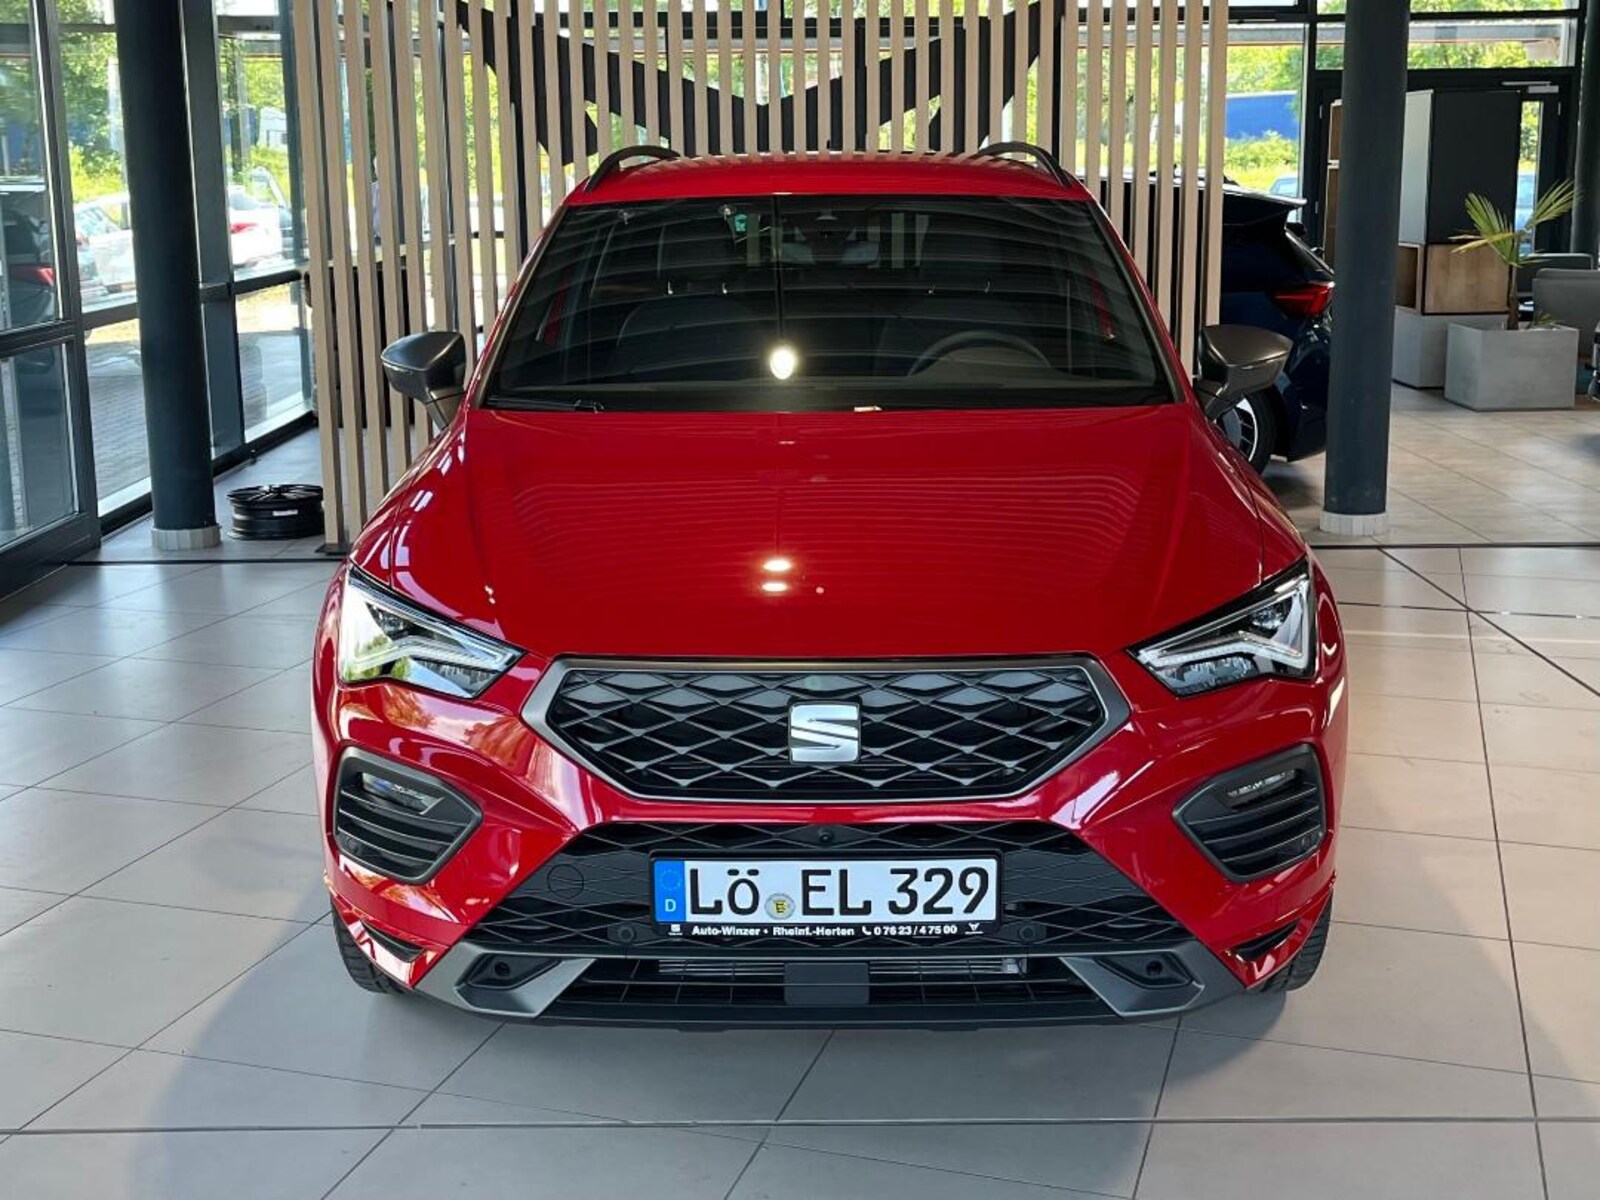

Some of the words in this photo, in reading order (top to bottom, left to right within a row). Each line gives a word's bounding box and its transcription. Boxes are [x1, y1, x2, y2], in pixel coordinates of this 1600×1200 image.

[690, 868, 760, 915] LÖ
[801, 869, 872, 916] EL
[888, 866, 989, 915] 329
[664, 899, 676, 912] D
[691, 925, 761, 936] Auto-Winzer
